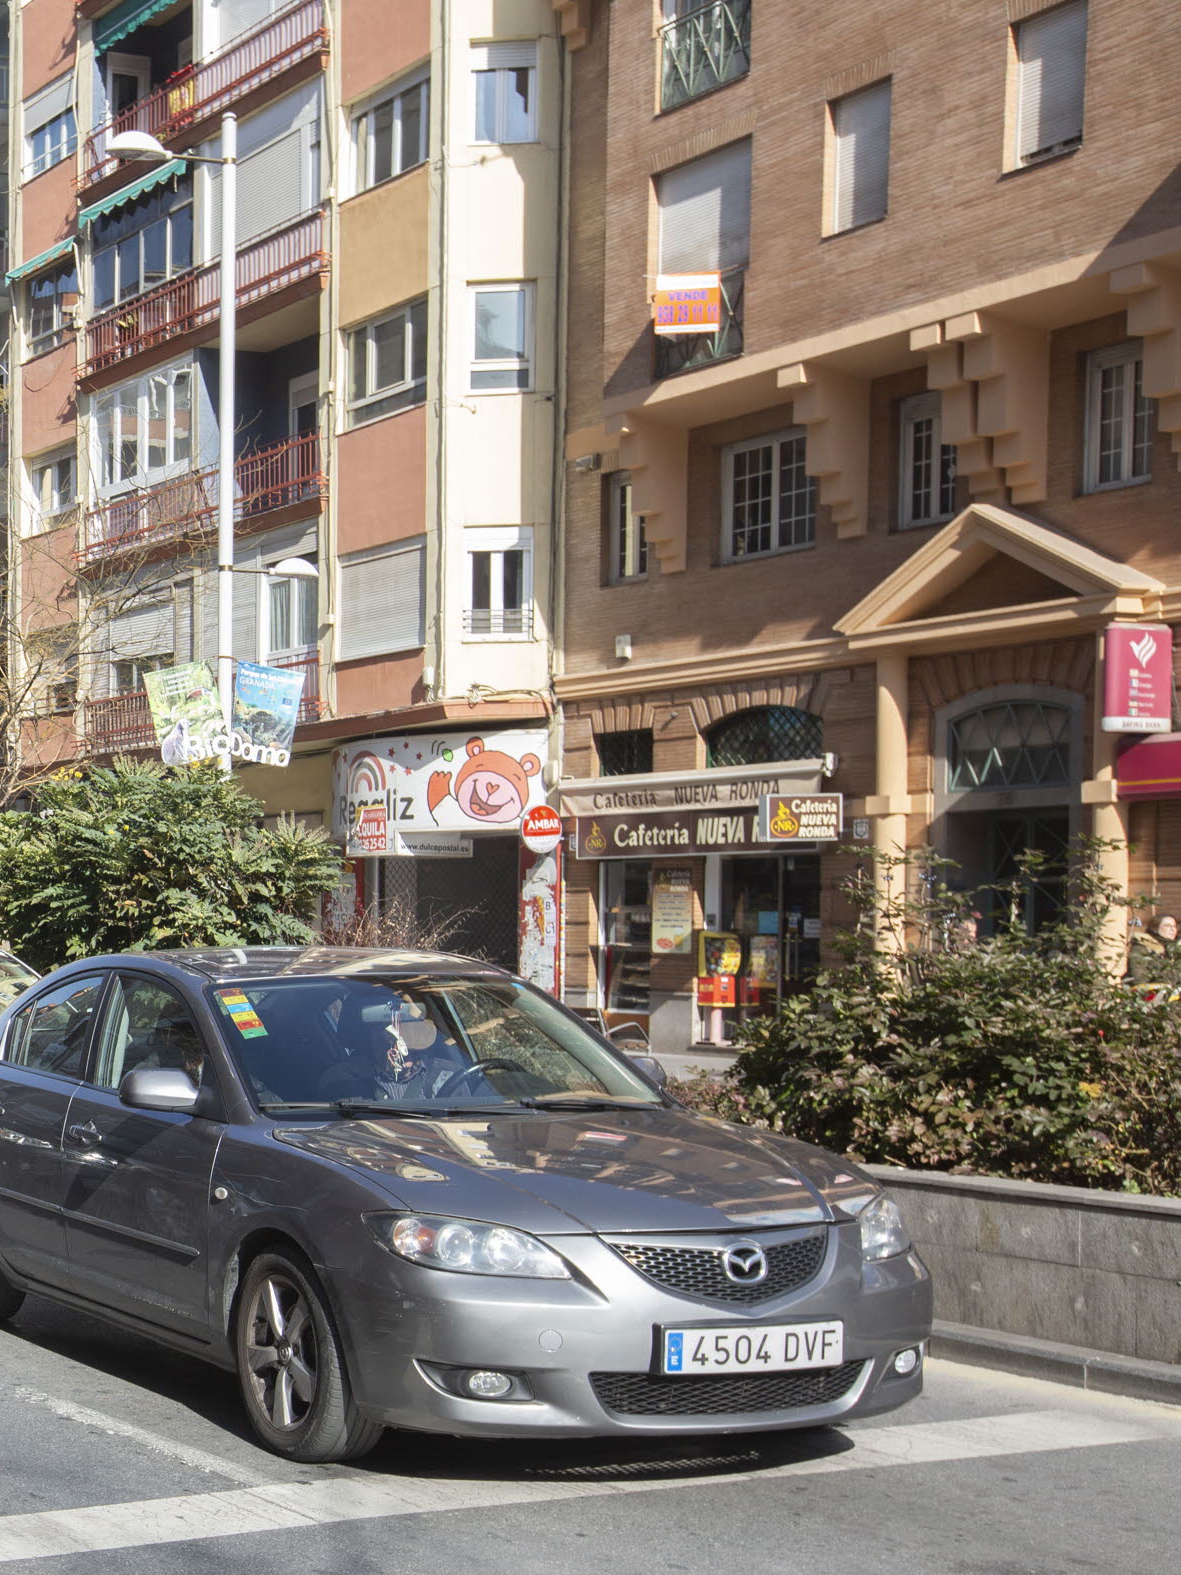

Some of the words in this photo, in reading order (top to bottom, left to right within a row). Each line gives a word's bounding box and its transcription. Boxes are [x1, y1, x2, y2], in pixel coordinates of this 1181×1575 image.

[668, 290, 707, 301] VENDE
[239, 677, 275, 689] GRANADA
[674, 785, 718, 805] NUEVA
[729, 779, 780, 801] RONDA
[528, 818, 559, 830] AMBAR
[800, 814, 837, 825] NUEVA
[697, 816, 745, 845] NUEVA
[798, 826, 835, 838] RONDA
[401, 840, 469, 852] www.dulcepostal.es
[671, 1355, 678, 1365] E
[692, 1334, 771, 1366] 4504
[784, 1329, 837, 1362] DVF
